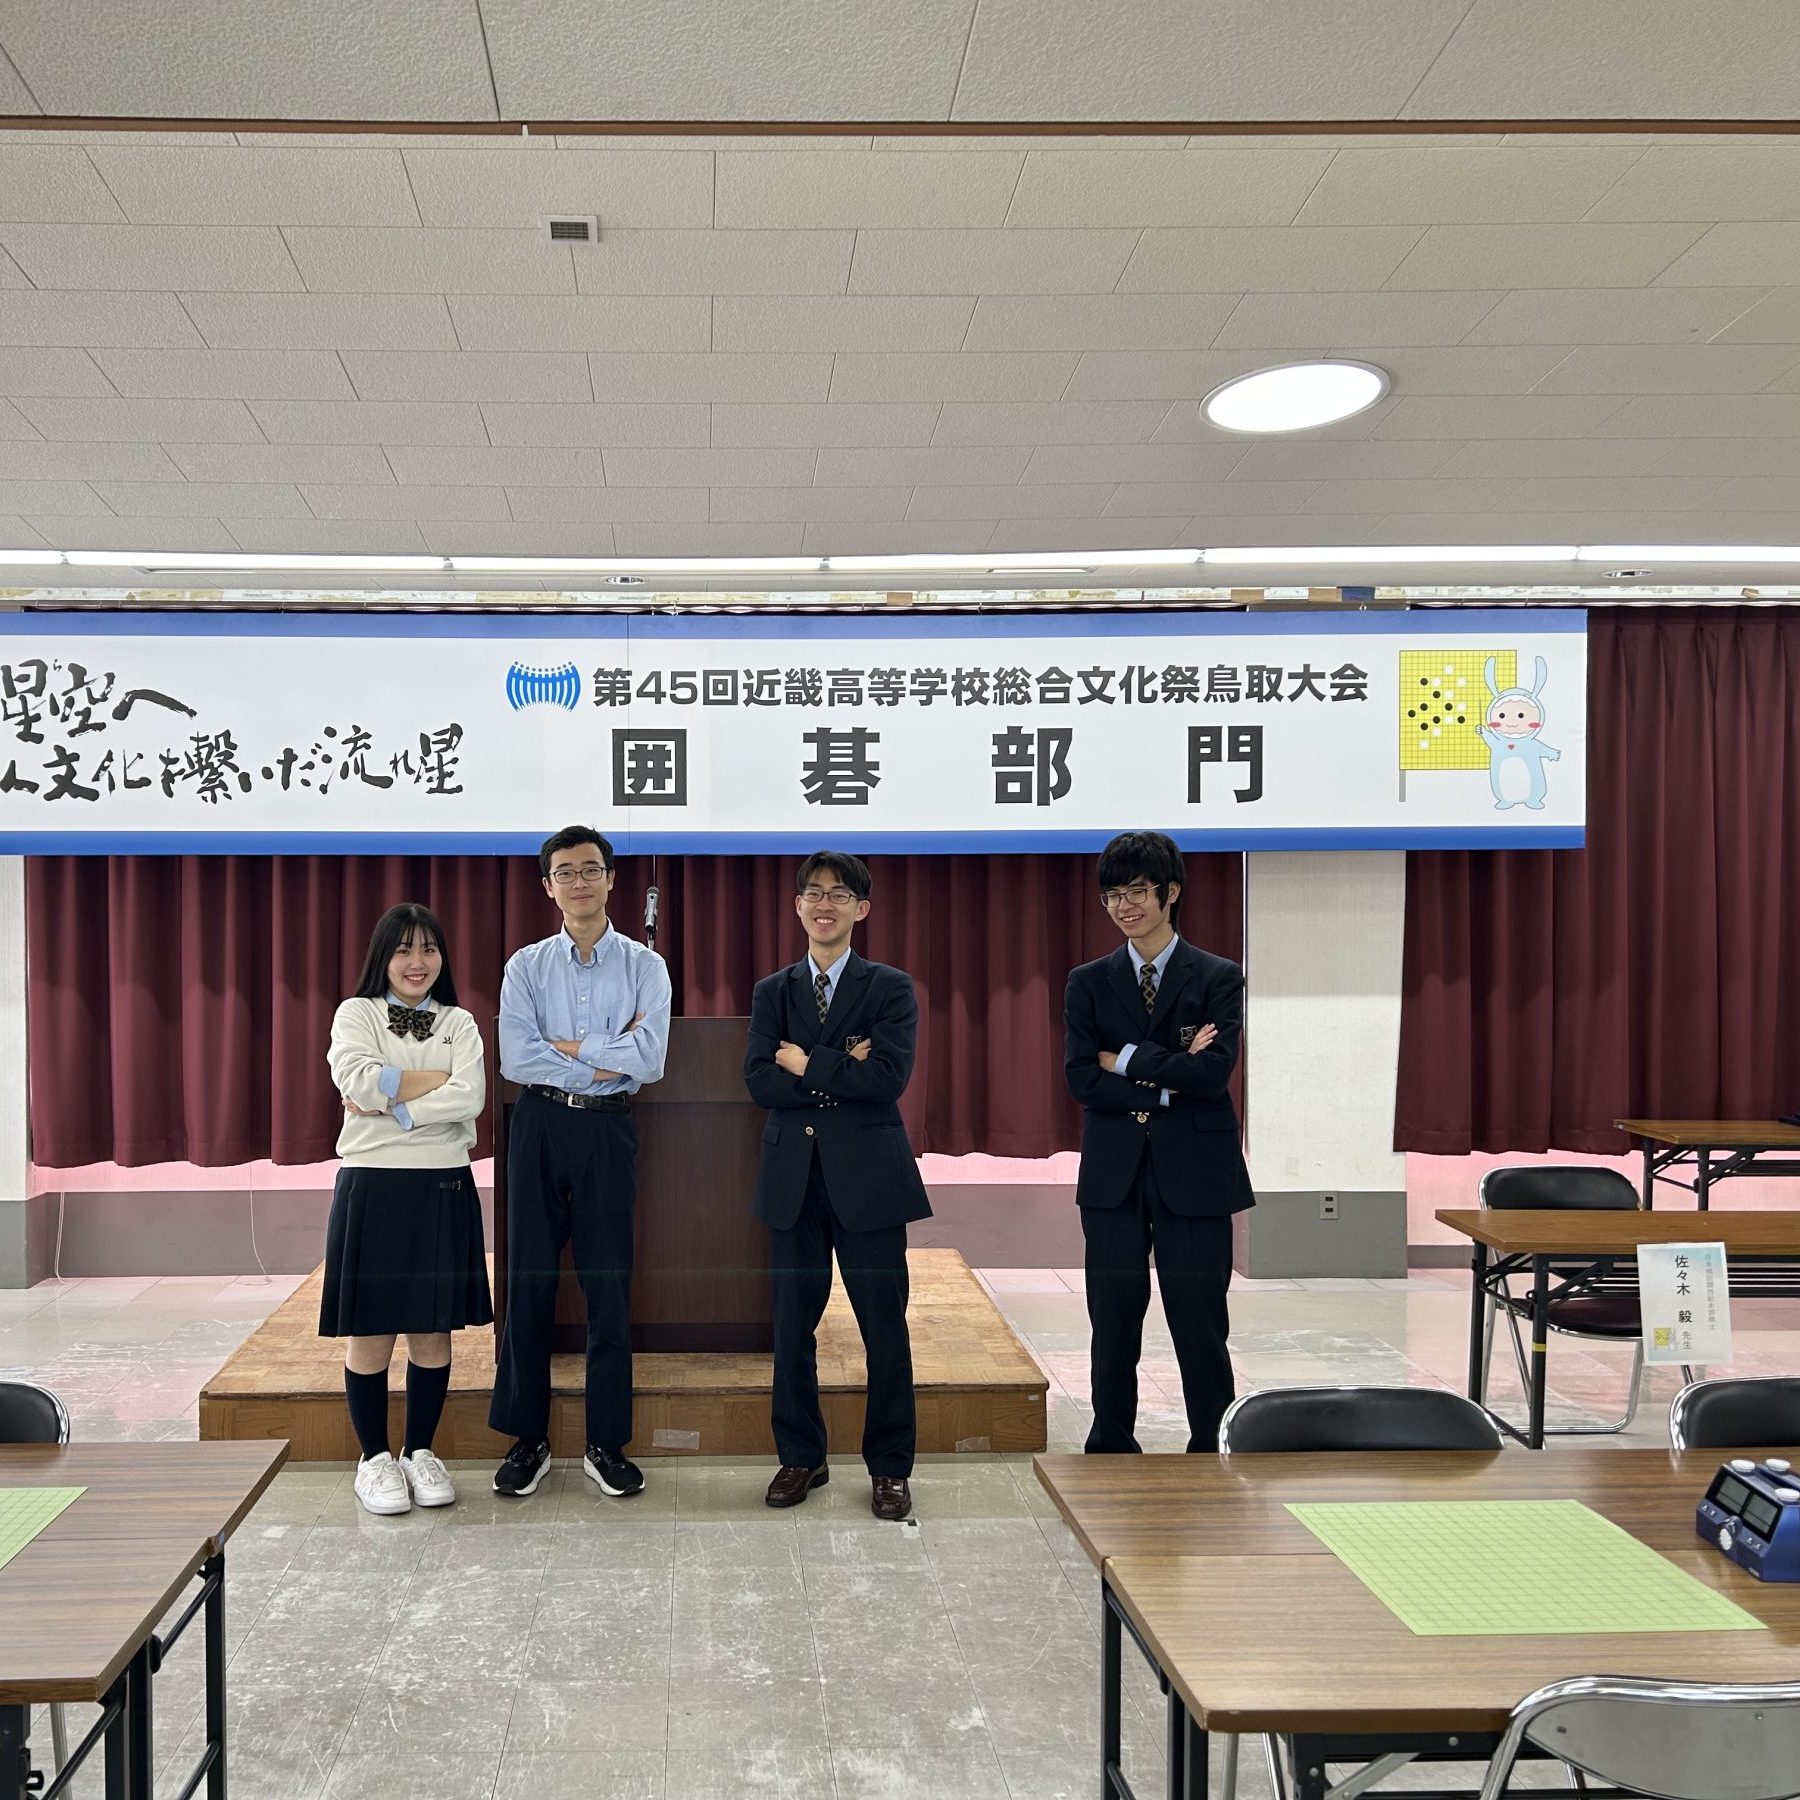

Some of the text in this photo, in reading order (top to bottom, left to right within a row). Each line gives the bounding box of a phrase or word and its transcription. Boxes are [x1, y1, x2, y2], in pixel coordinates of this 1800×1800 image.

[593, 664, 1368, 707] 第45回近畿高等学校総合文化祭鳥取大会
[1675, 1255, 1691, 1296] 佐々木
[1678, 1310, 1693, 1323] 毅
